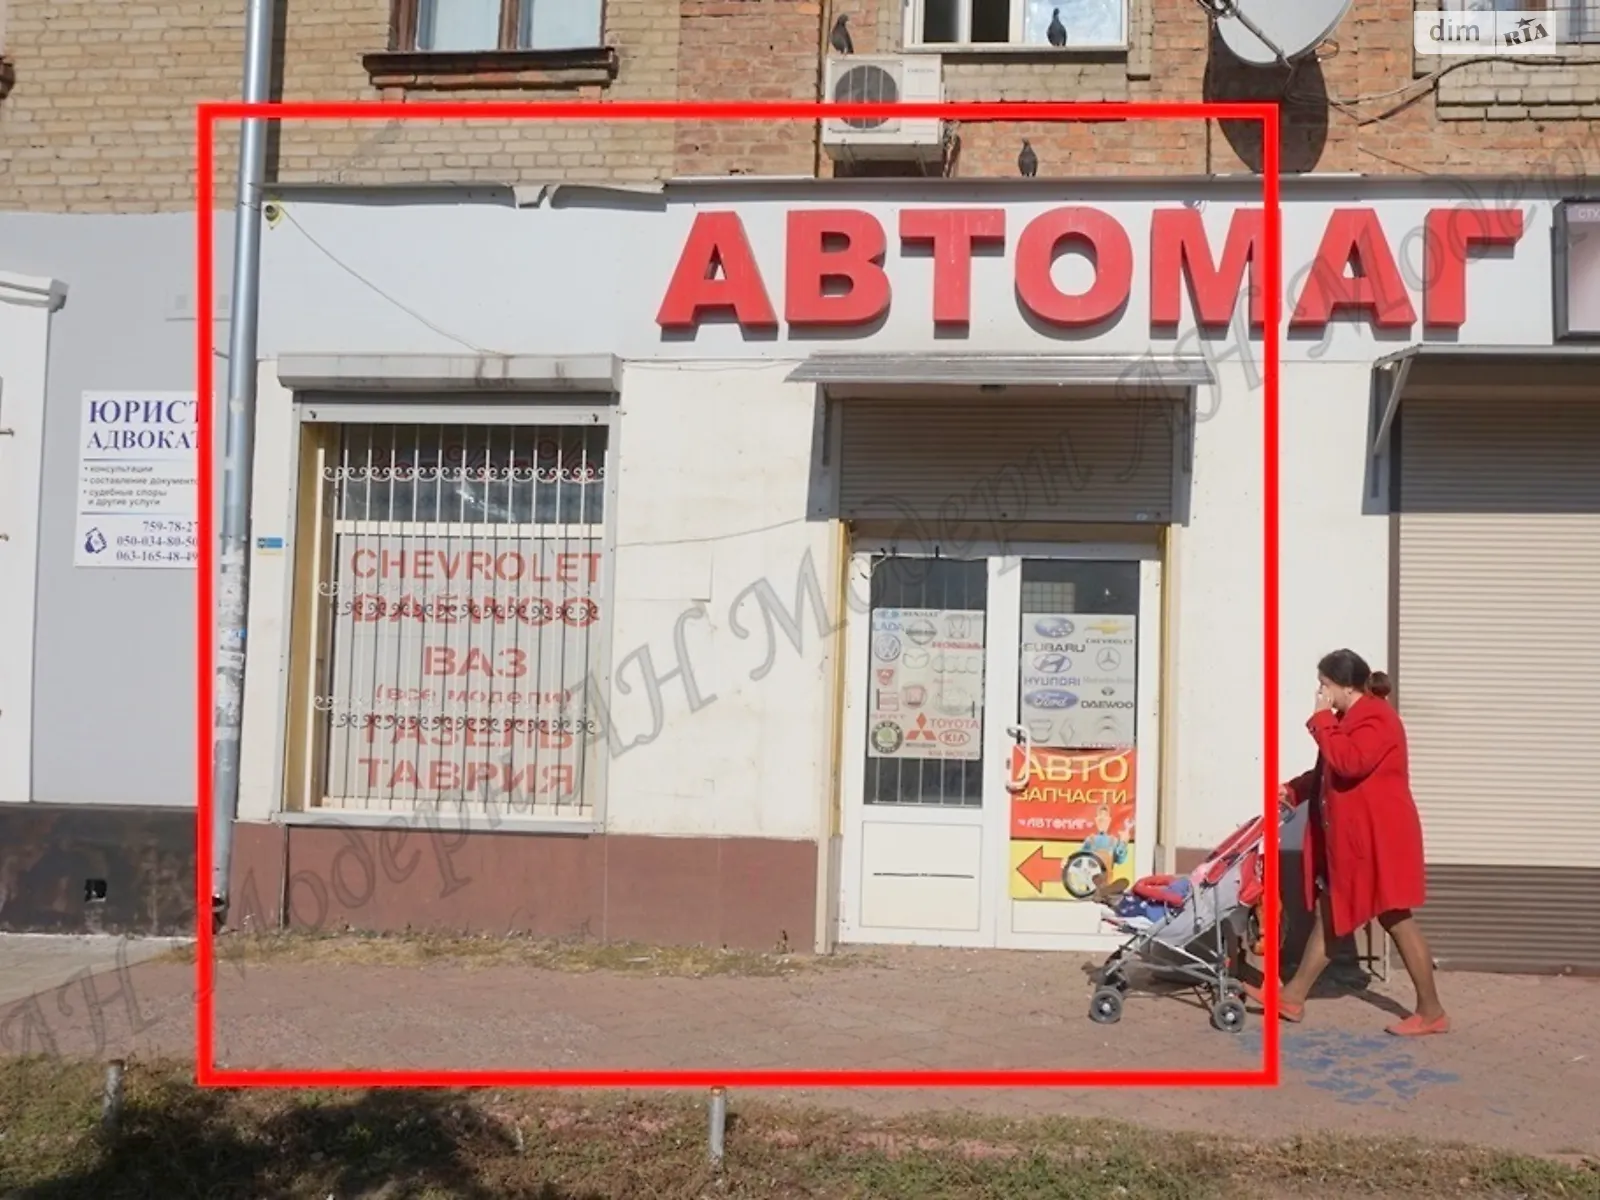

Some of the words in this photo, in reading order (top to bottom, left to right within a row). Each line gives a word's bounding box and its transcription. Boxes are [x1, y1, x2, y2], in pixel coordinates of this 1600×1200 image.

[655, 206, 1524, 338] АВТОМАГ
[136, 489, 168, 498] споры
[350, 548, 602, 583] CHEVROLET
[1022, 642, 1087, 653] SUBARU
[423, 646, 528, 678] ВАЗ
[1032, 692, 1069, 708] Ford
[1081, 699, 1135, 710] DAEWOO
[930, 717, 981, 730] TOYOTA
[944, 734, 967, 744] KIA
[358, 757, 573, 795] ТАВРИЯ
[1016, 753, 1130, 784] АВТО
[1016, 786, 1128, 805] ЗАПЧАСТИ
